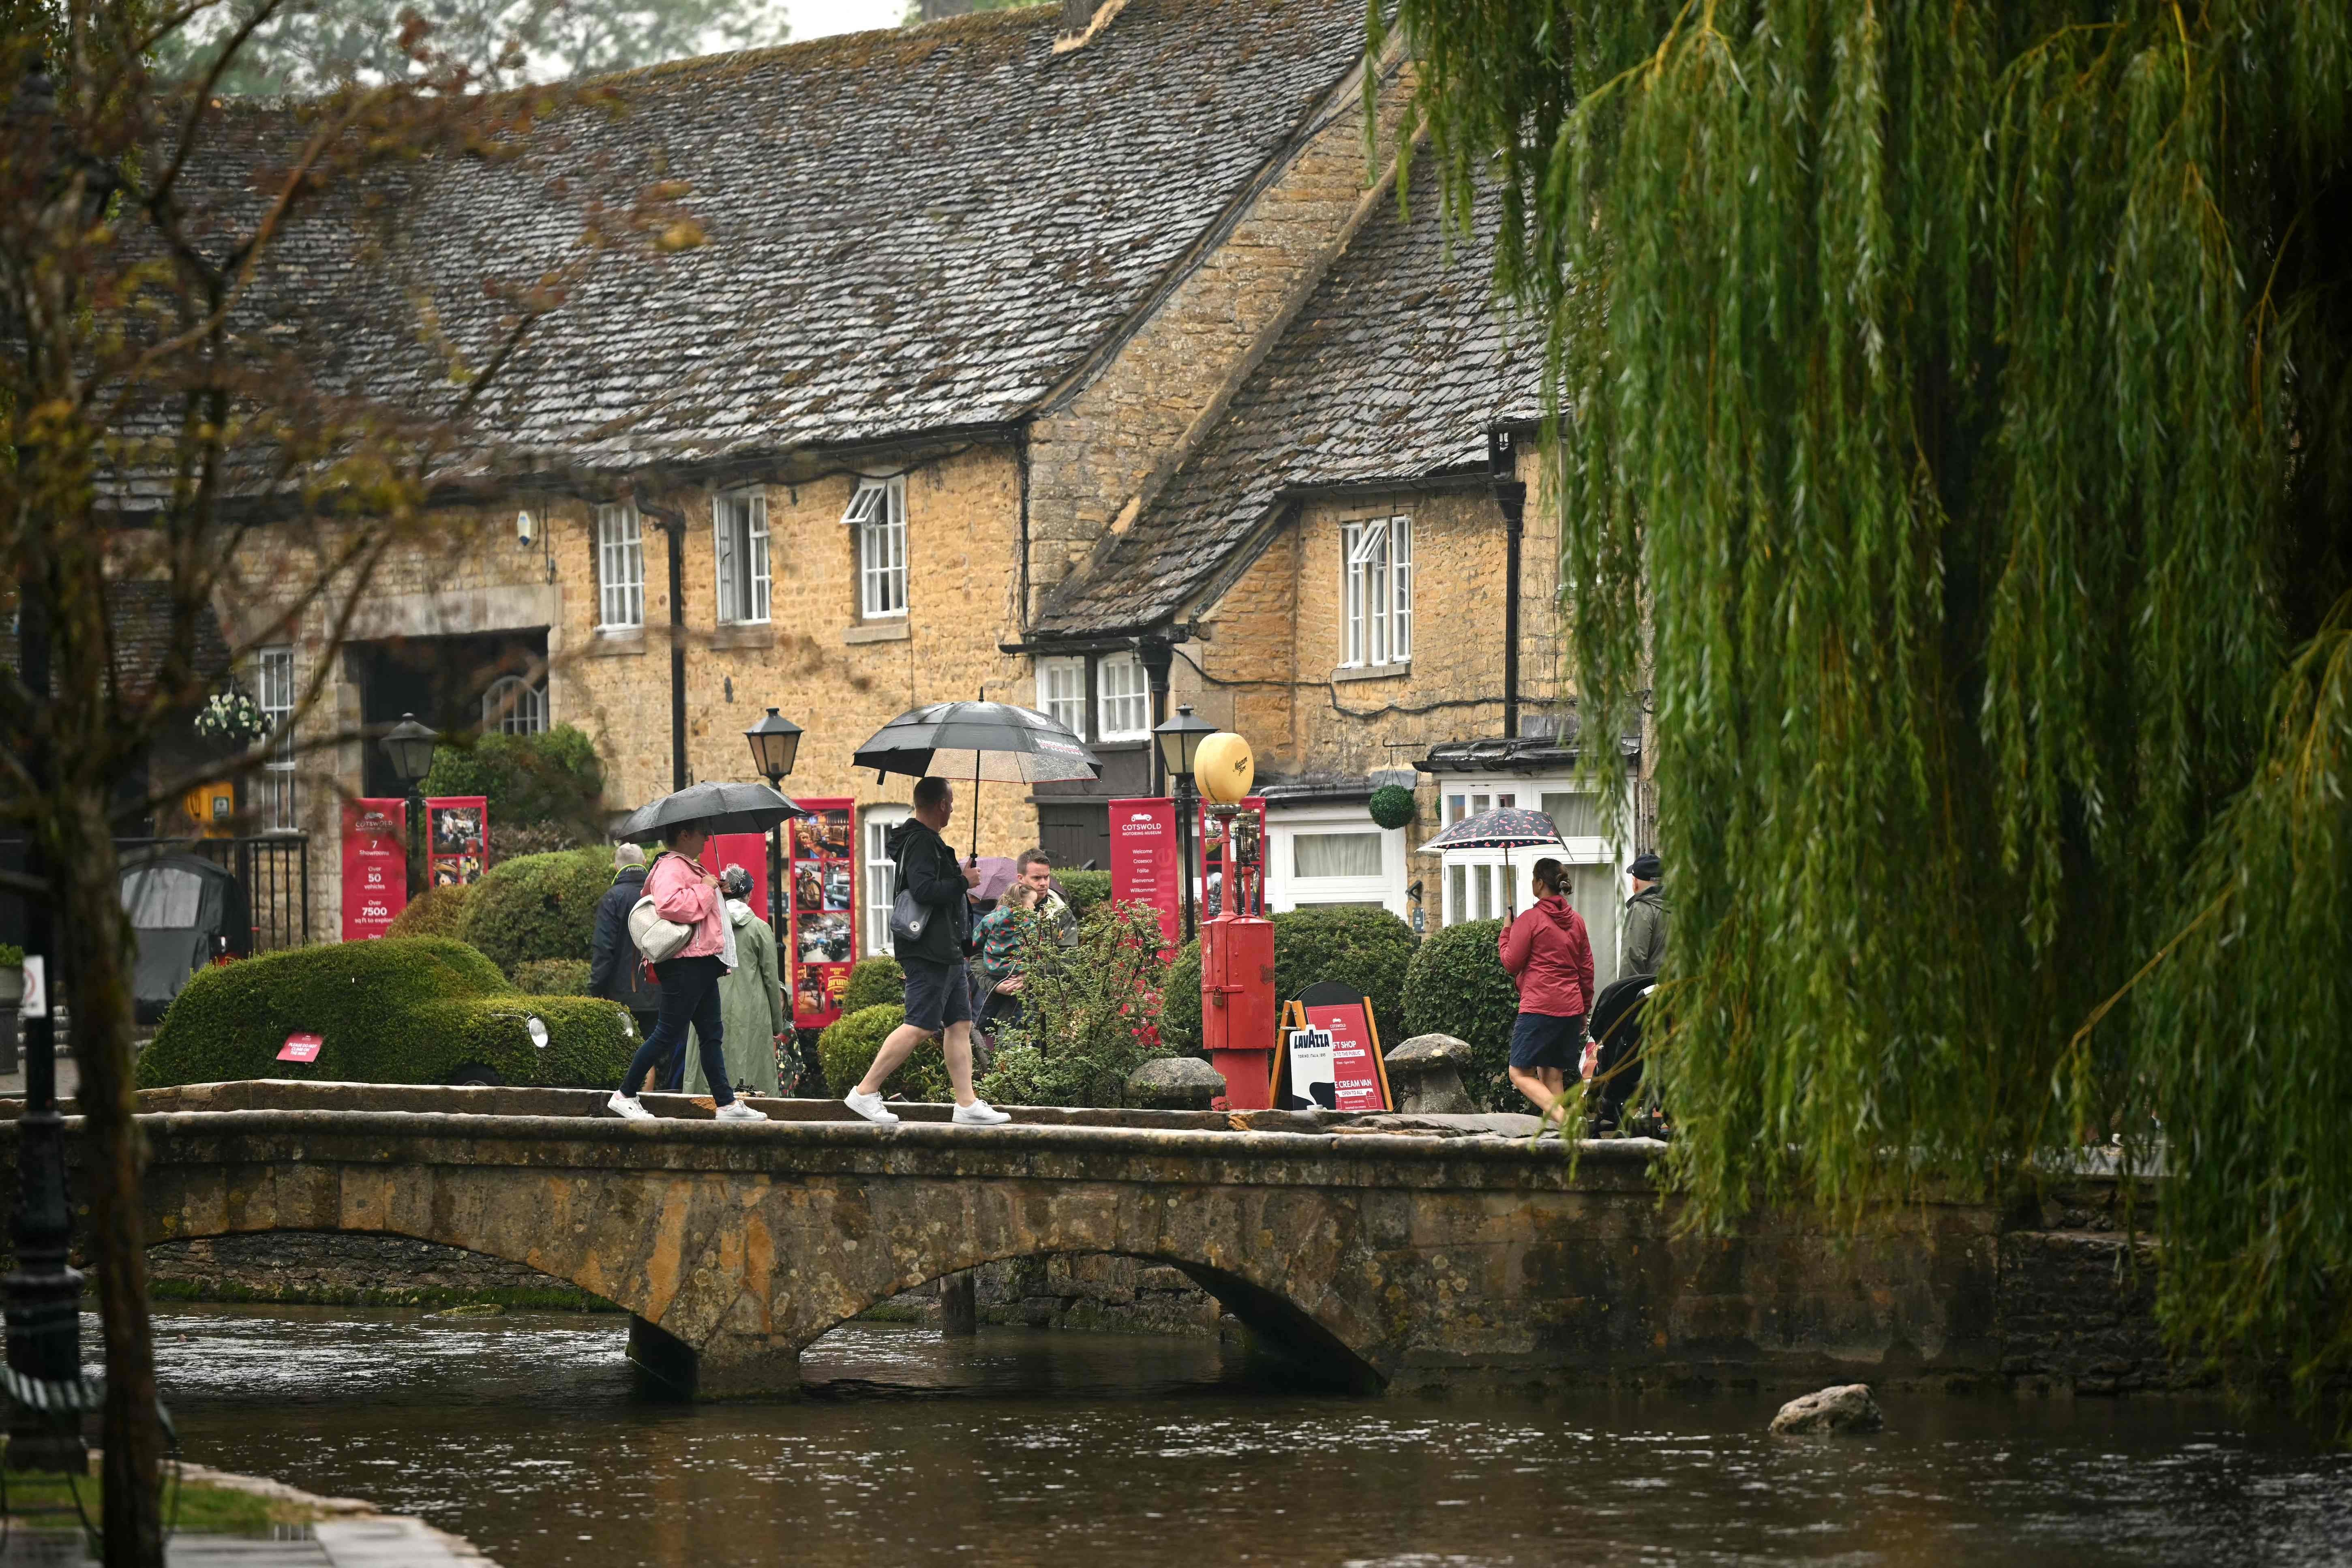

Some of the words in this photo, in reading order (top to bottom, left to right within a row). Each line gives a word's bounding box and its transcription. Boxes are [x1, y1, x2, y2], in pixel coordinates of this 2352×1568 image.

[1035, 738, 1080, 750] SUNDERLAND
[1051, 747, 1084, 756] SCOTLAND
[1233, 756, 1247, 772] Museum
[1238, 765, 1246, 776] Here
[372, 840, 377, 848] 7
[368, 874, 381, 882] 50
[362, 907, 387, 916] 7500
[1294, 1030, 1330, 1049] LAVAZZA
[1341, 1041, 1356, 1049] SHOP
[1339, 1080, 1360, 1088] CREAM
